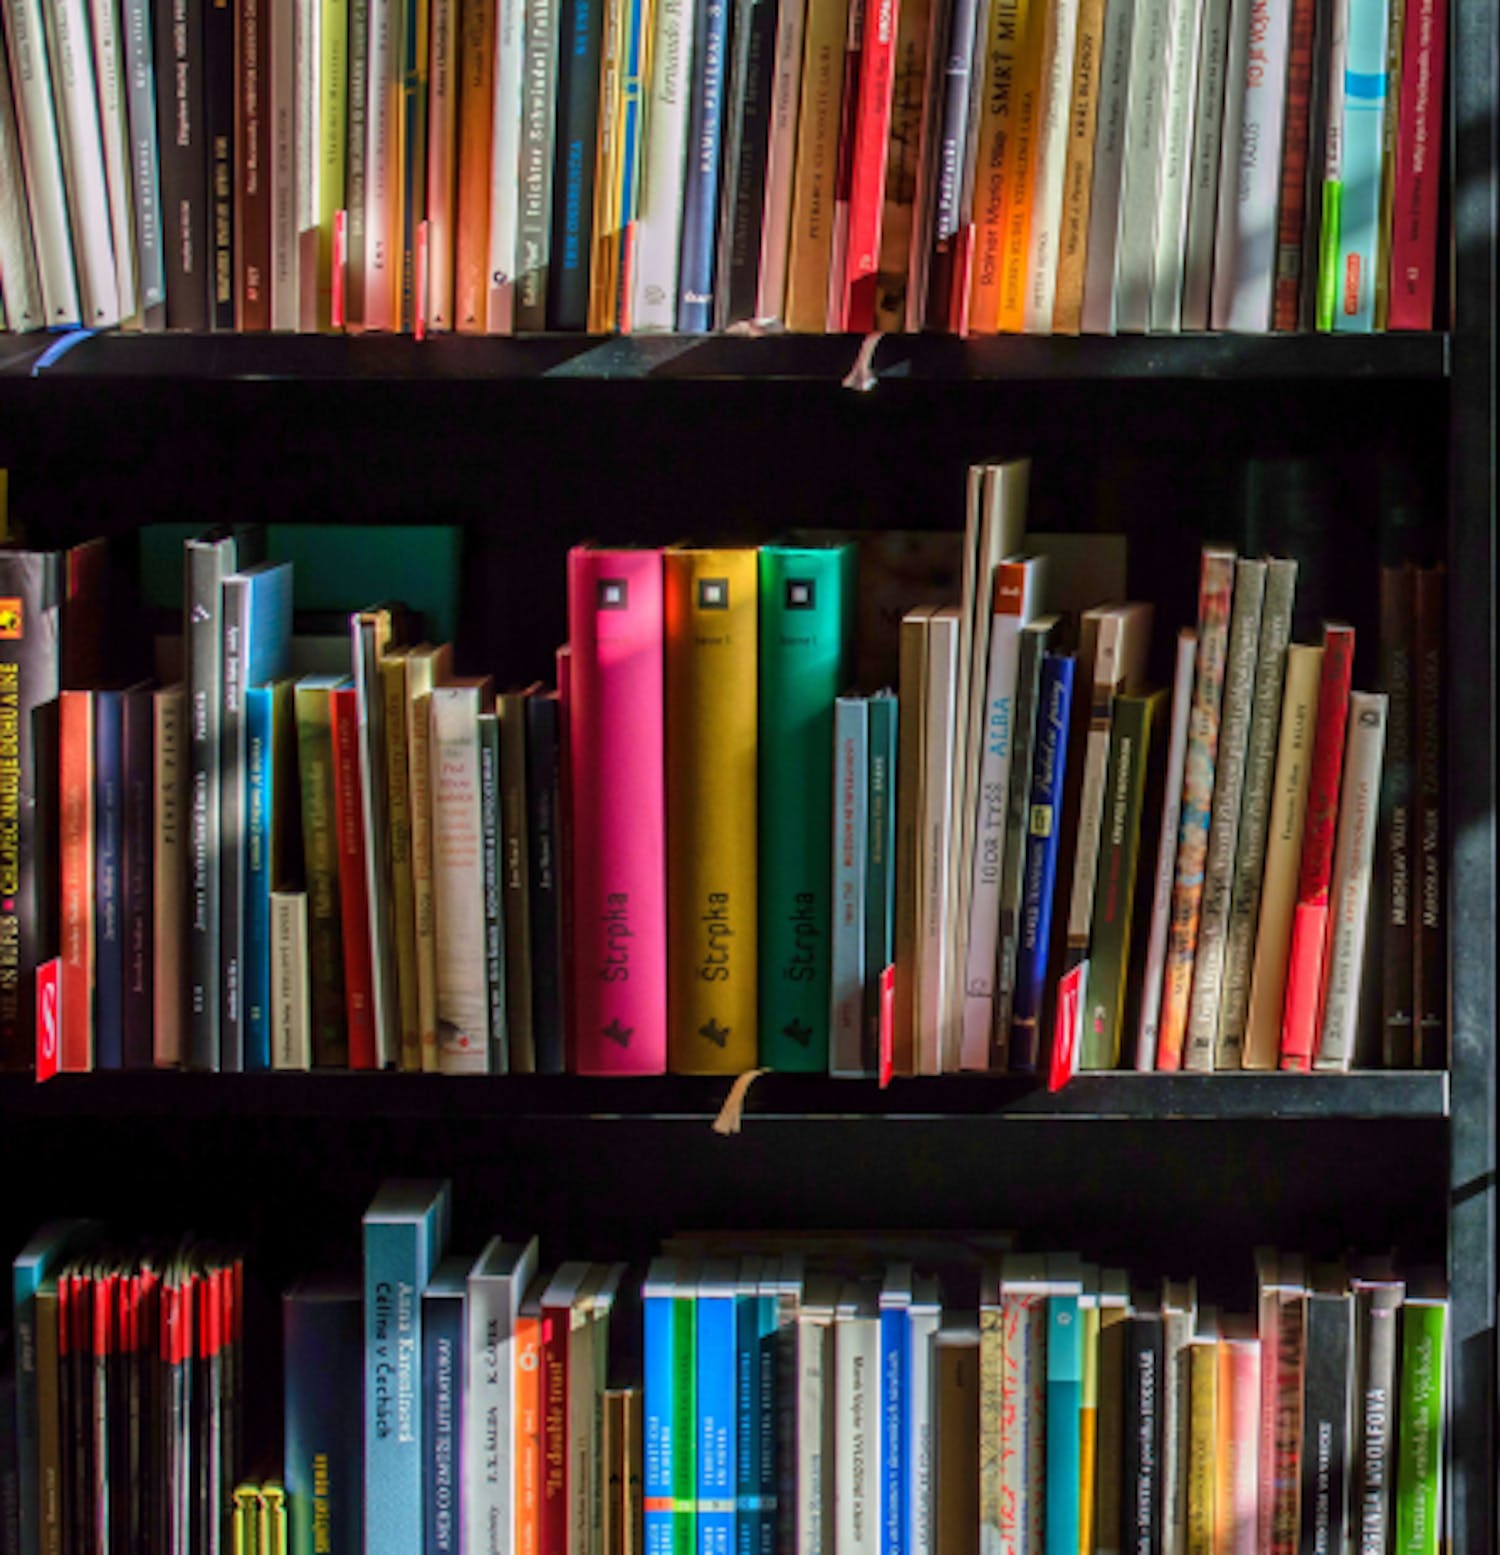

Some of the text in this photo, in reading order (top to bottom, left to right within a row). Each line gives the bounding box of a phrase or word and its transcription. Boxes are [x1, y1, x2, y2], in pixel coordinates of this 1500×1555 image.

[987, 696, 1011, 759] ALBA
[596, 890, 632, 984] Štrpka
[696, 890, 734, 984] Štrpka
